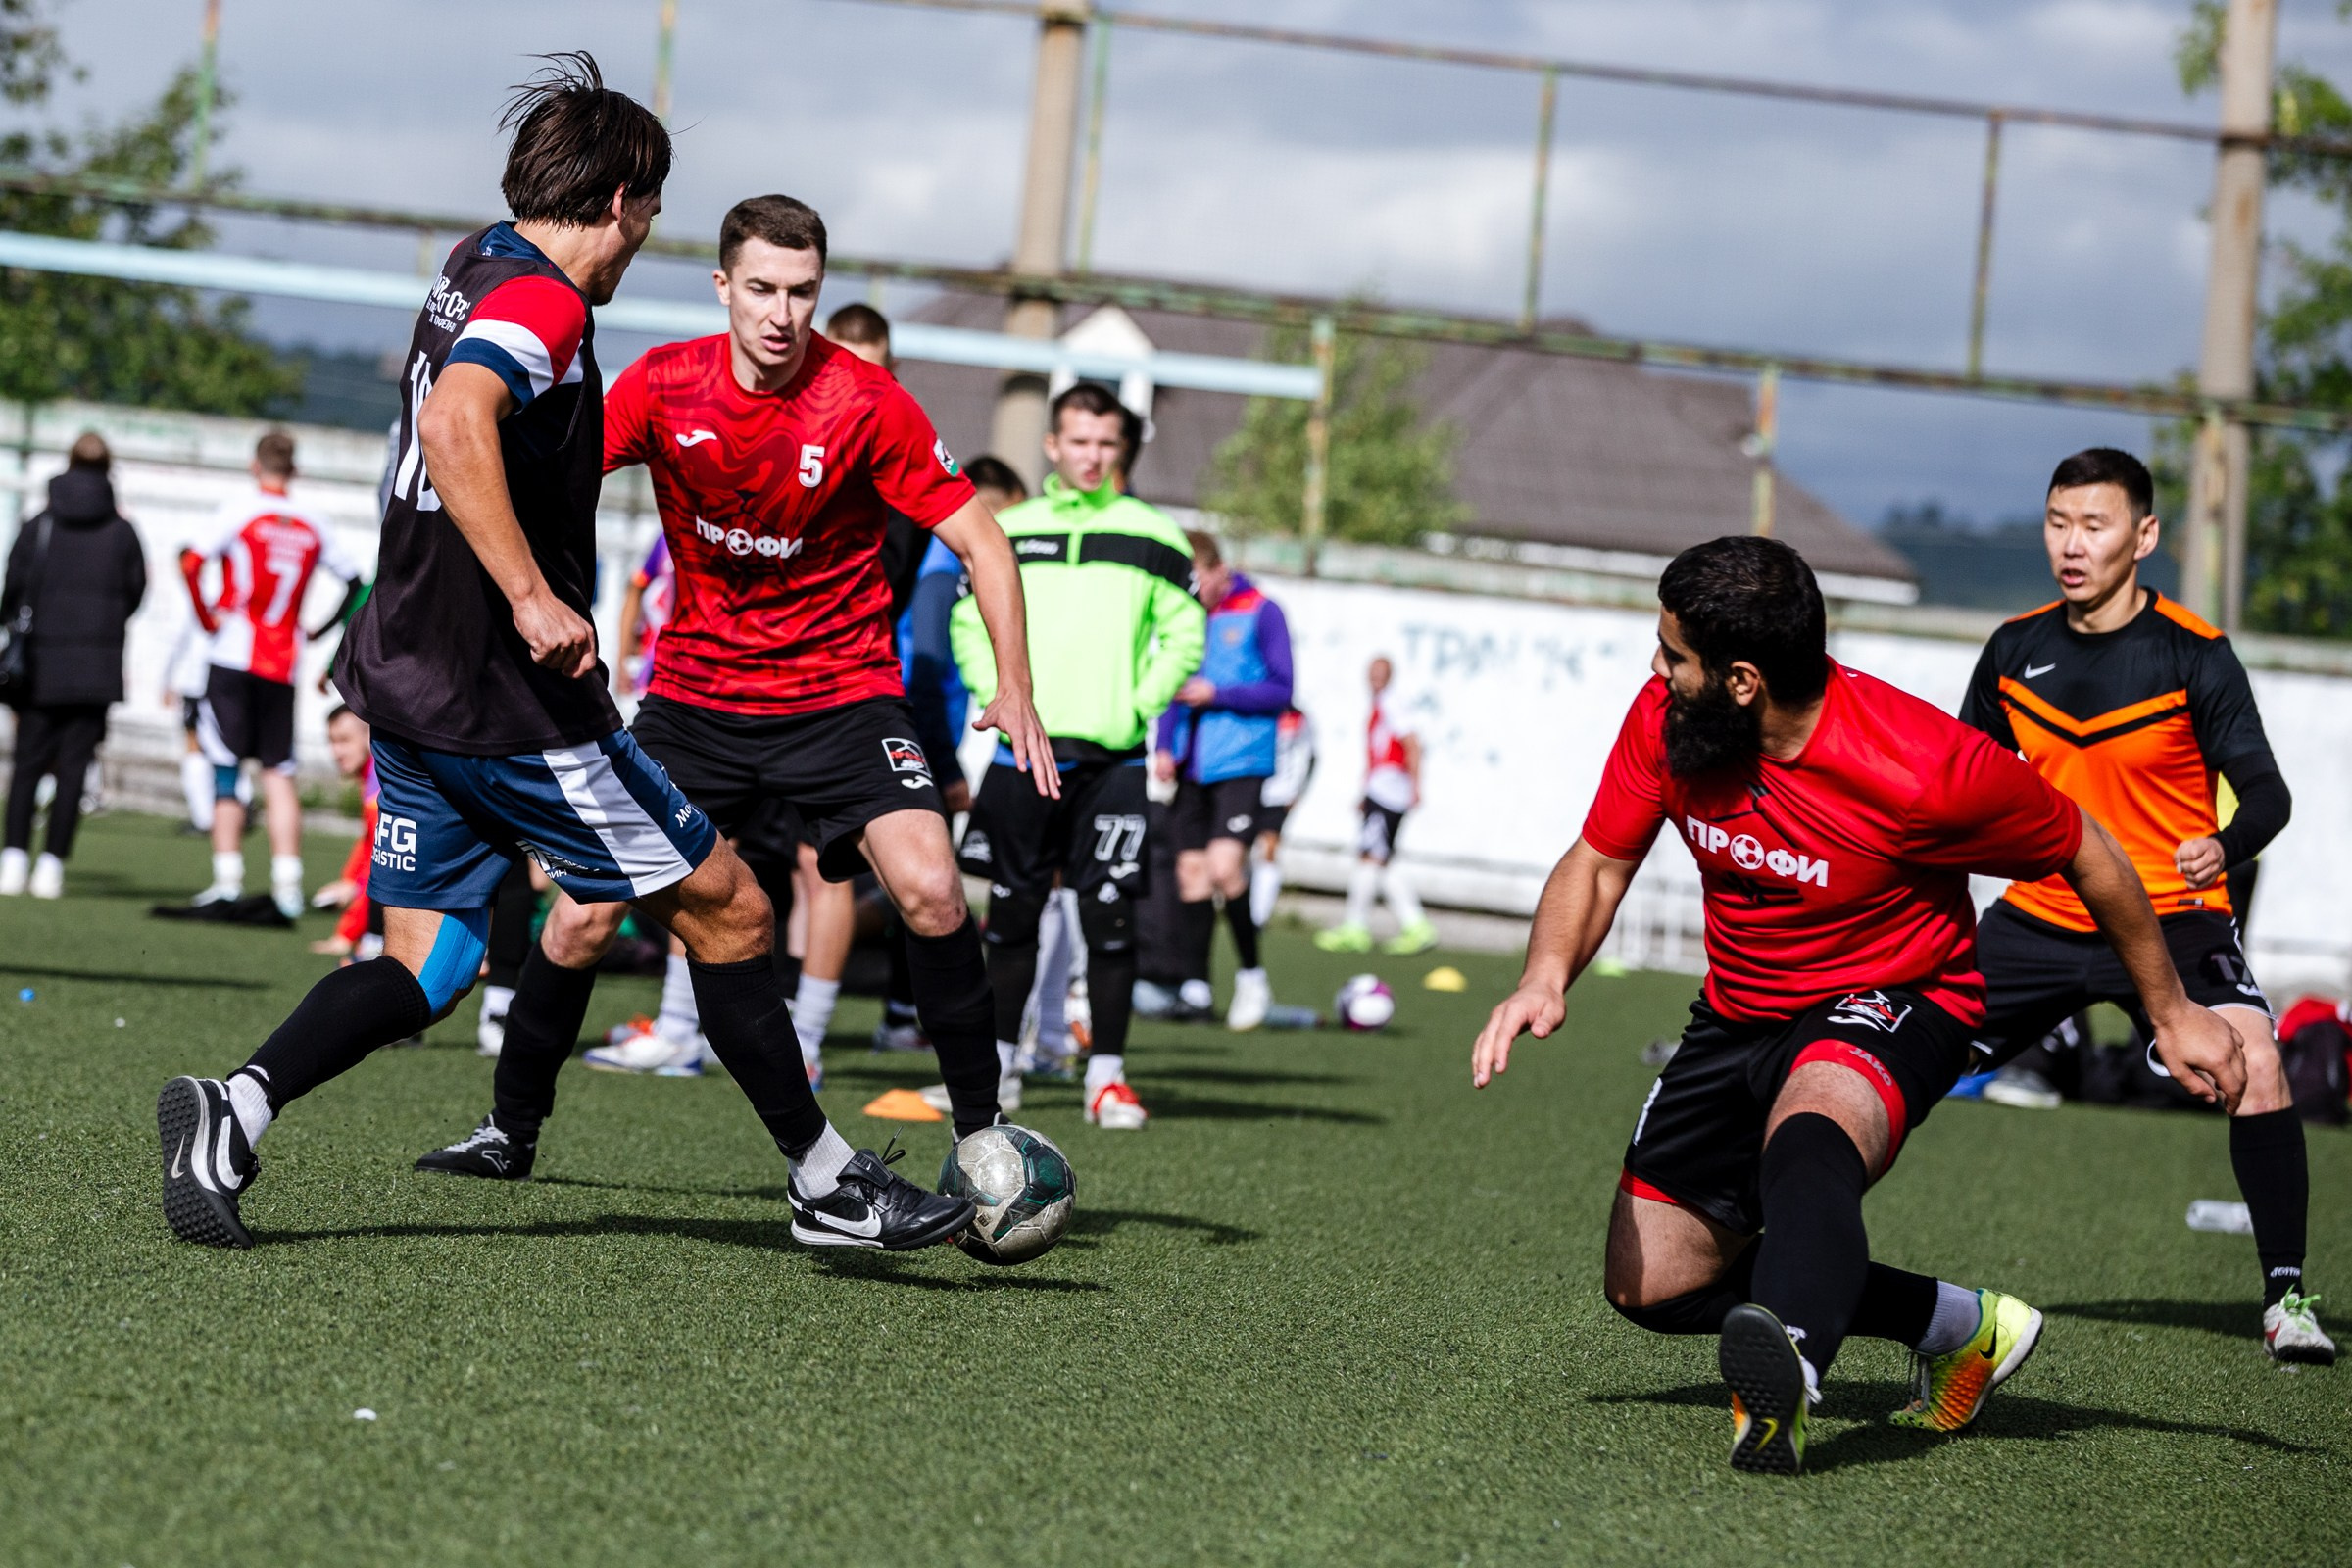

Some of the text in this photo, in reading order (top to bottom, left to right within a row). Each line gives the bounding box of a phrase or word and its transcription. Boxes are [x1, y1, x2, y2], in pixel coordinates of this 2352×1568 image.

[798, 443, 825, 488] 5
[695, 514, 803, 560] ПРОФИ
[261, 558, 304, 628] 7
[1094, 813, 1147, 861] 77
[1686, 814, 1830, 888] ПРОФИ
[1848, 1047, 1893, 1087] JAKO
